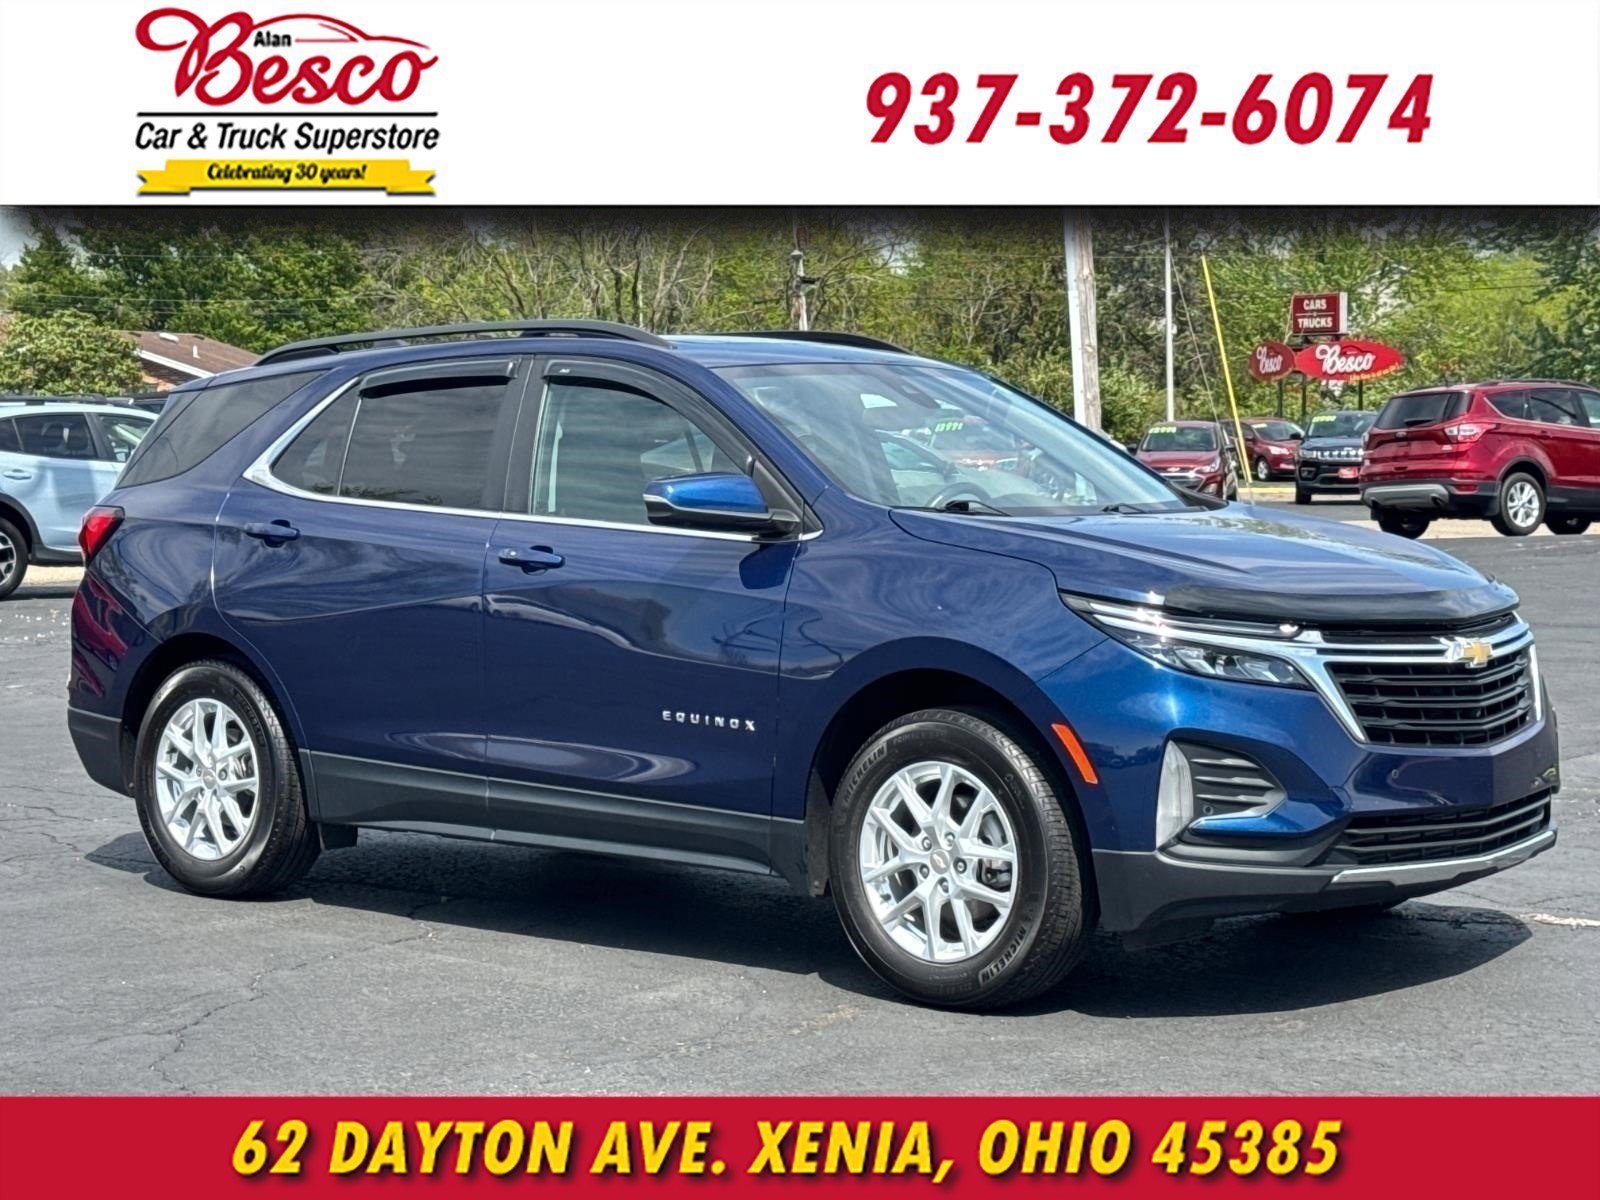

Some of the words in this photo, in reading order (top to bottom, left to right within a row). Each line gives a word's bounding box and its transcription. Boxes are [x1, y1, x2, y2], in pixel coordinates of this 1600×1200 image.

[1303, 299, 1327, 311] CARS
[1298, 317, 1333, 329] TRUCKS
[1315, 344, 1376, 375] Besco
[661, 710, 756, 732] EQUINOX
[843, 745, 885, 802] MICHELIN
[981, 924, 1027, 984] MICHELIN
